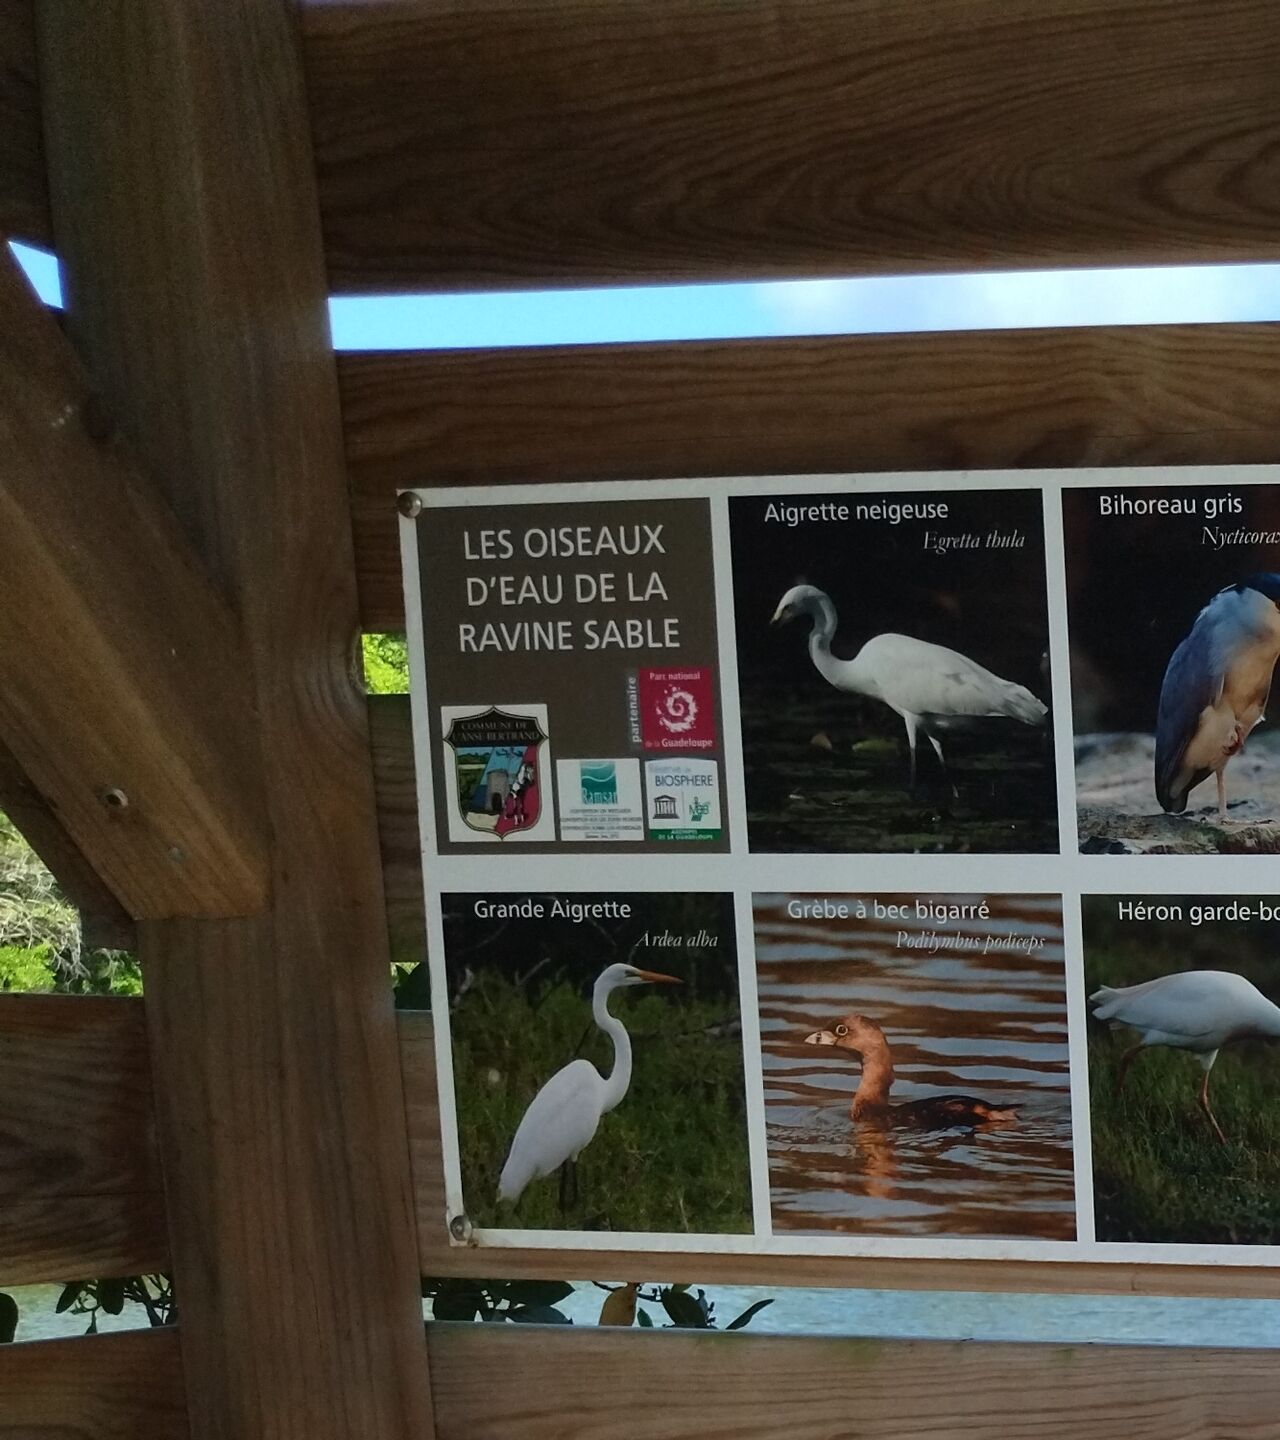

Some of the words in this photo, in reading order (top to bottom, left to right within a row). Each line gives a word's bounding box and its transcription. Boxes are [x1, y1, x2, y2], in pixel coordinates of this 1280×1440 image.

[764, 501, 849, 526] Aigrette
[856, 500, 949, 524] neigeuse
[1099, 494, 1197, 516] Bihoreau
[1203, 493, 1243, 519] gris
[463, 529, 513, 561] LES
[524, 524, 666, 557] OISEAUX
[922, 531, 981, 554] Egretta
[986, 530, 1025, 550] thula
[576, 573, 616, 604] DE
[627, 571, 669, 602] LA
[459, 620, 574, 653] RAVINE
[584, 618, 680, 650] SABLE
[668, 671, 701, 681] national
[627, 676, 642, 743] partenaire
[661, 737, 713, 750] Guadeloupe
[655, 775, 713, 787] BIOSPHERE
[474, 900, 545, 920] Grande
[550, 899, 632, 924] Aigrette
[788, 899, 850, 920] Grèbe
[855, 900, 868, 919] à
[874, 899, 909, 920] bec
[916, 899, 990, 925] bigarré
[1118, 900, 1183, 922] Héron
[635, 929, 682, 949] Ardea
[686, 929, 719, 949] alba
[895, 929, 980, 953] Podilymbus
[983, 931, 1046, 955] podiceps
